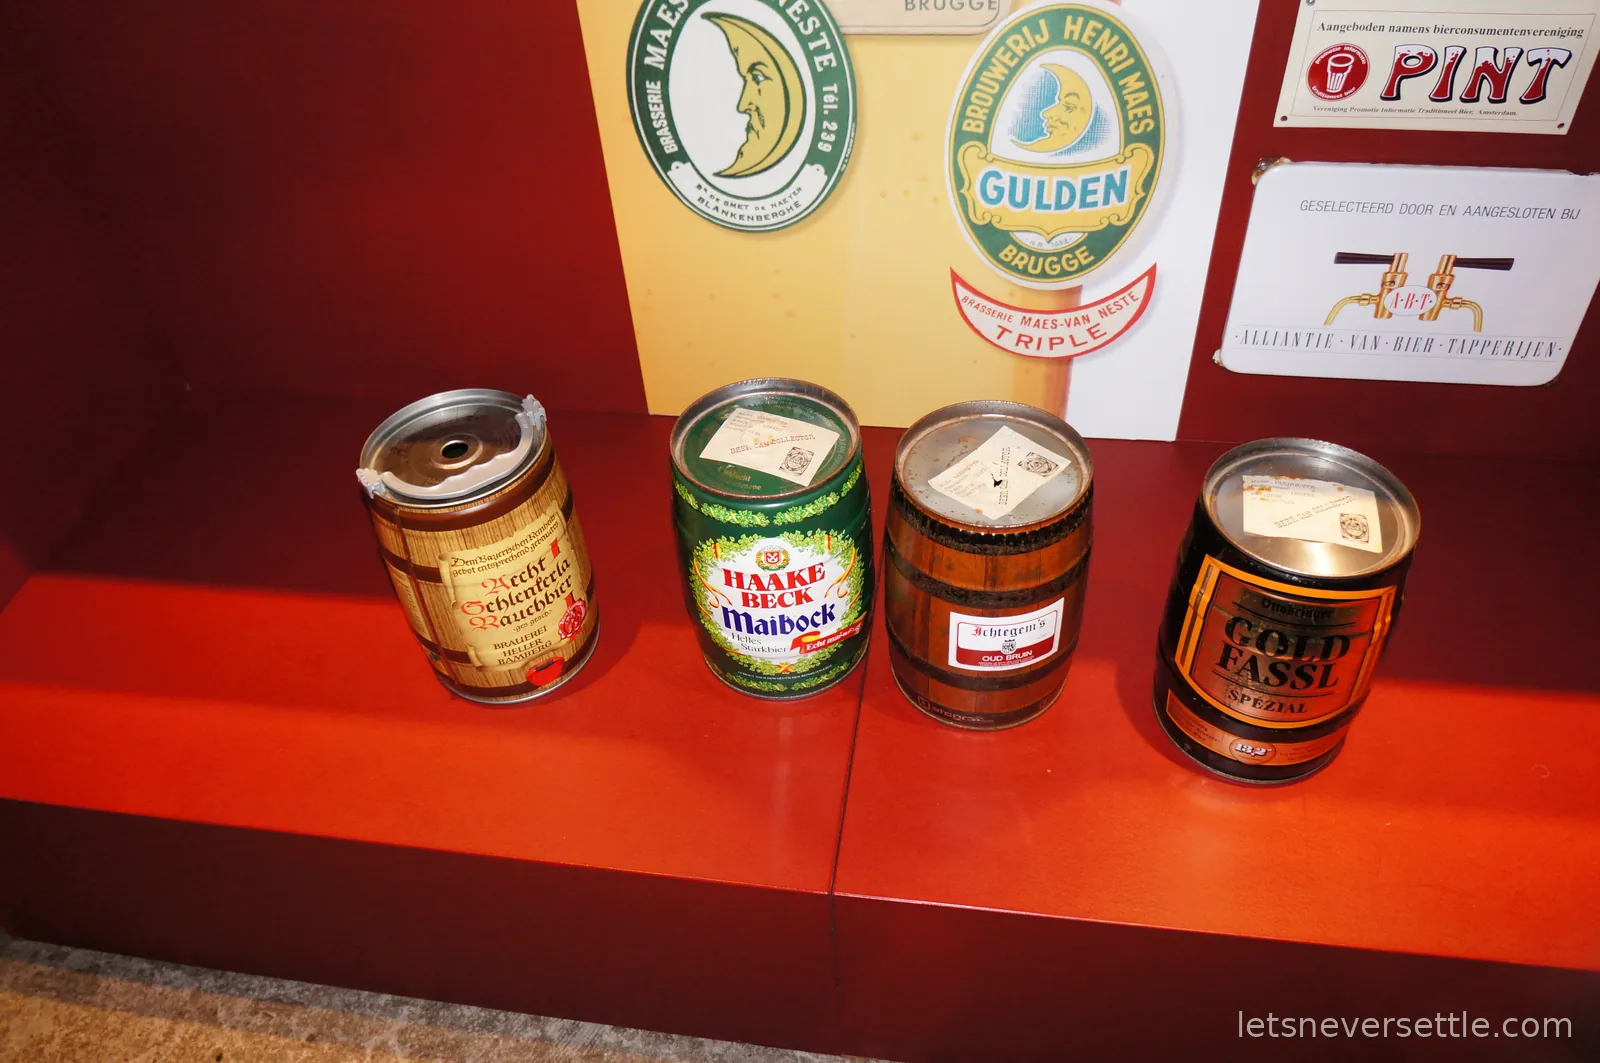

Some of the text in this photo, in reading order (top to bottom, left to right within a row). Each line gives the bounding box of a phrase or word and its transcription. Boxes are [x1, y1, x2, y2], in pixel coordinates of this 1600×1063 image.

[643, 0, 690, 71] MAES
[1316, 20, 1585, 39] Aangeboden namens bierconsumentenvereniging
[962, 14, 1155, 136] BROUWERIJ HENRI MAES
[1379, 43, 1573, 105] PINT
[822, 83, 838, 115] Tél.
[1313, 105, 1348, 113] Vereniging
[1349, 106, 1380, 114] Promotie
[1418, 107, 1458, 115] Traditioneel
[646, 80, 678, 154] BRASSERIE
[817, 120, 838, 152] 239
[723, 200, 750, 211] SMET
[770, 186, 803, 209] NAEYER
[979, 169, 1128, 211] GULDEN
[697, 196, 802, 222] BLANKENBERGHE
[1300, 200, 1581, 221] GESELECTEERD DOOR EN AANGESLOTEN BIJ
[998, 244, 1096, 276] BRUGGE
[961, 290, 1140, 330] BRASSERIE MAES-VAN NESTE
[997, 322, 1108, 351] TRIPLE
[1239, 329, 1558, 359] ALLIANTIE VAN BIER TAPPERIJEN
[450, 556, 479, 567] Dem
[481, 556, 546, 597] Aecht
[722, 562, 826, 592] HAAKE
[740, 587, 815, 609] BECK
[721, 603, 836, 636] Maibock
[971, 619, 1047, 637] Ichtegem's
[493, 625, 548, 650] BRAUEREI
[503, 638, 544, 657] HELLER
[731, 632, 762, 645] Helles
[740, 643, 788, 653] Starkbier
[806, 640, 826, 651] Echt
[1225, 616, 1350, 661] GOLD
[498, 640, 552, 665] BAMBERG
[1006, 649, 1033, 661] BRUIN
[1216, 641, 1339, 689] FASSL
